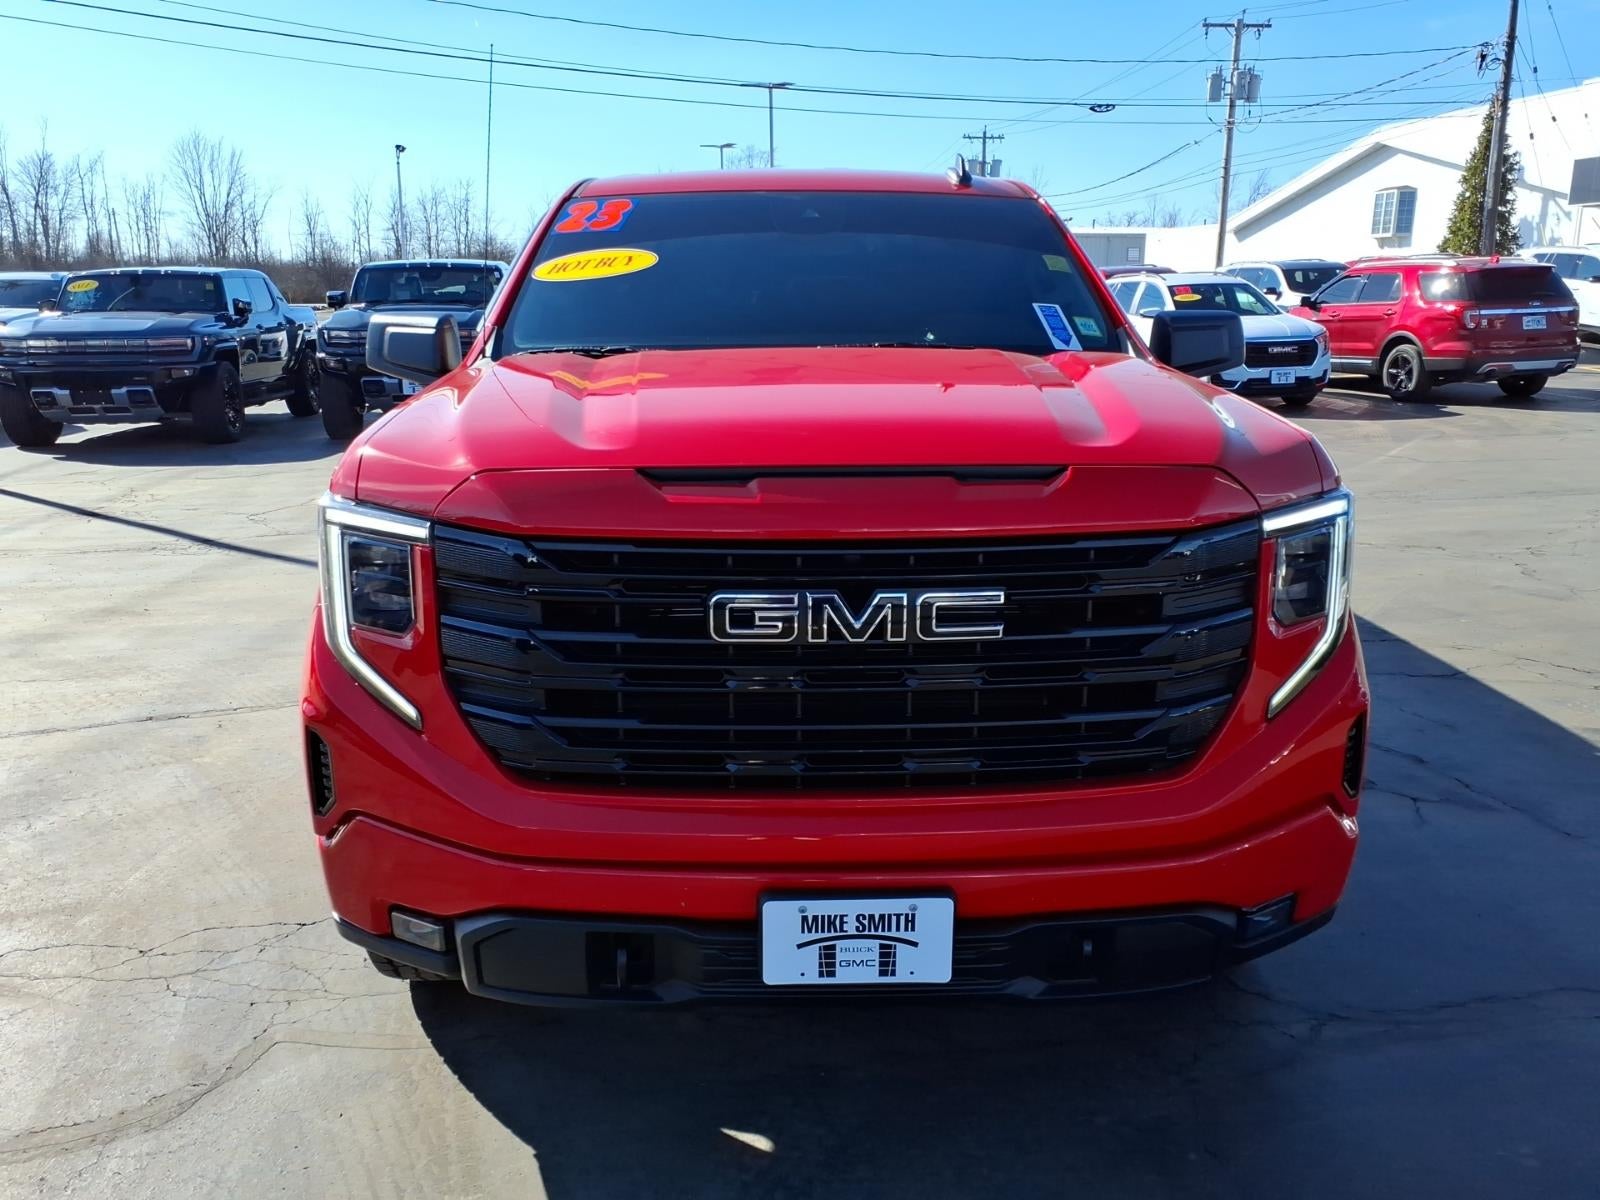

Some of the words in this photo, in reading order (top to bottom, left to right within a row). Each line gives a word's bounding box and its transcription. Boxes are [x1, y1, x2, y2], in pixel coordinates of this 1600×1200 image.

[555, 199, 632, 232] 23
[547, 258, 597, 275] HOT
[595, 255, 638, 269] BUY
[708, 591, 1005, 643] GMC
[800, 914, 849, 934] MIKE
[855, 913, 916, 933] SMITH
[839, 959, 876, 967] GMC
